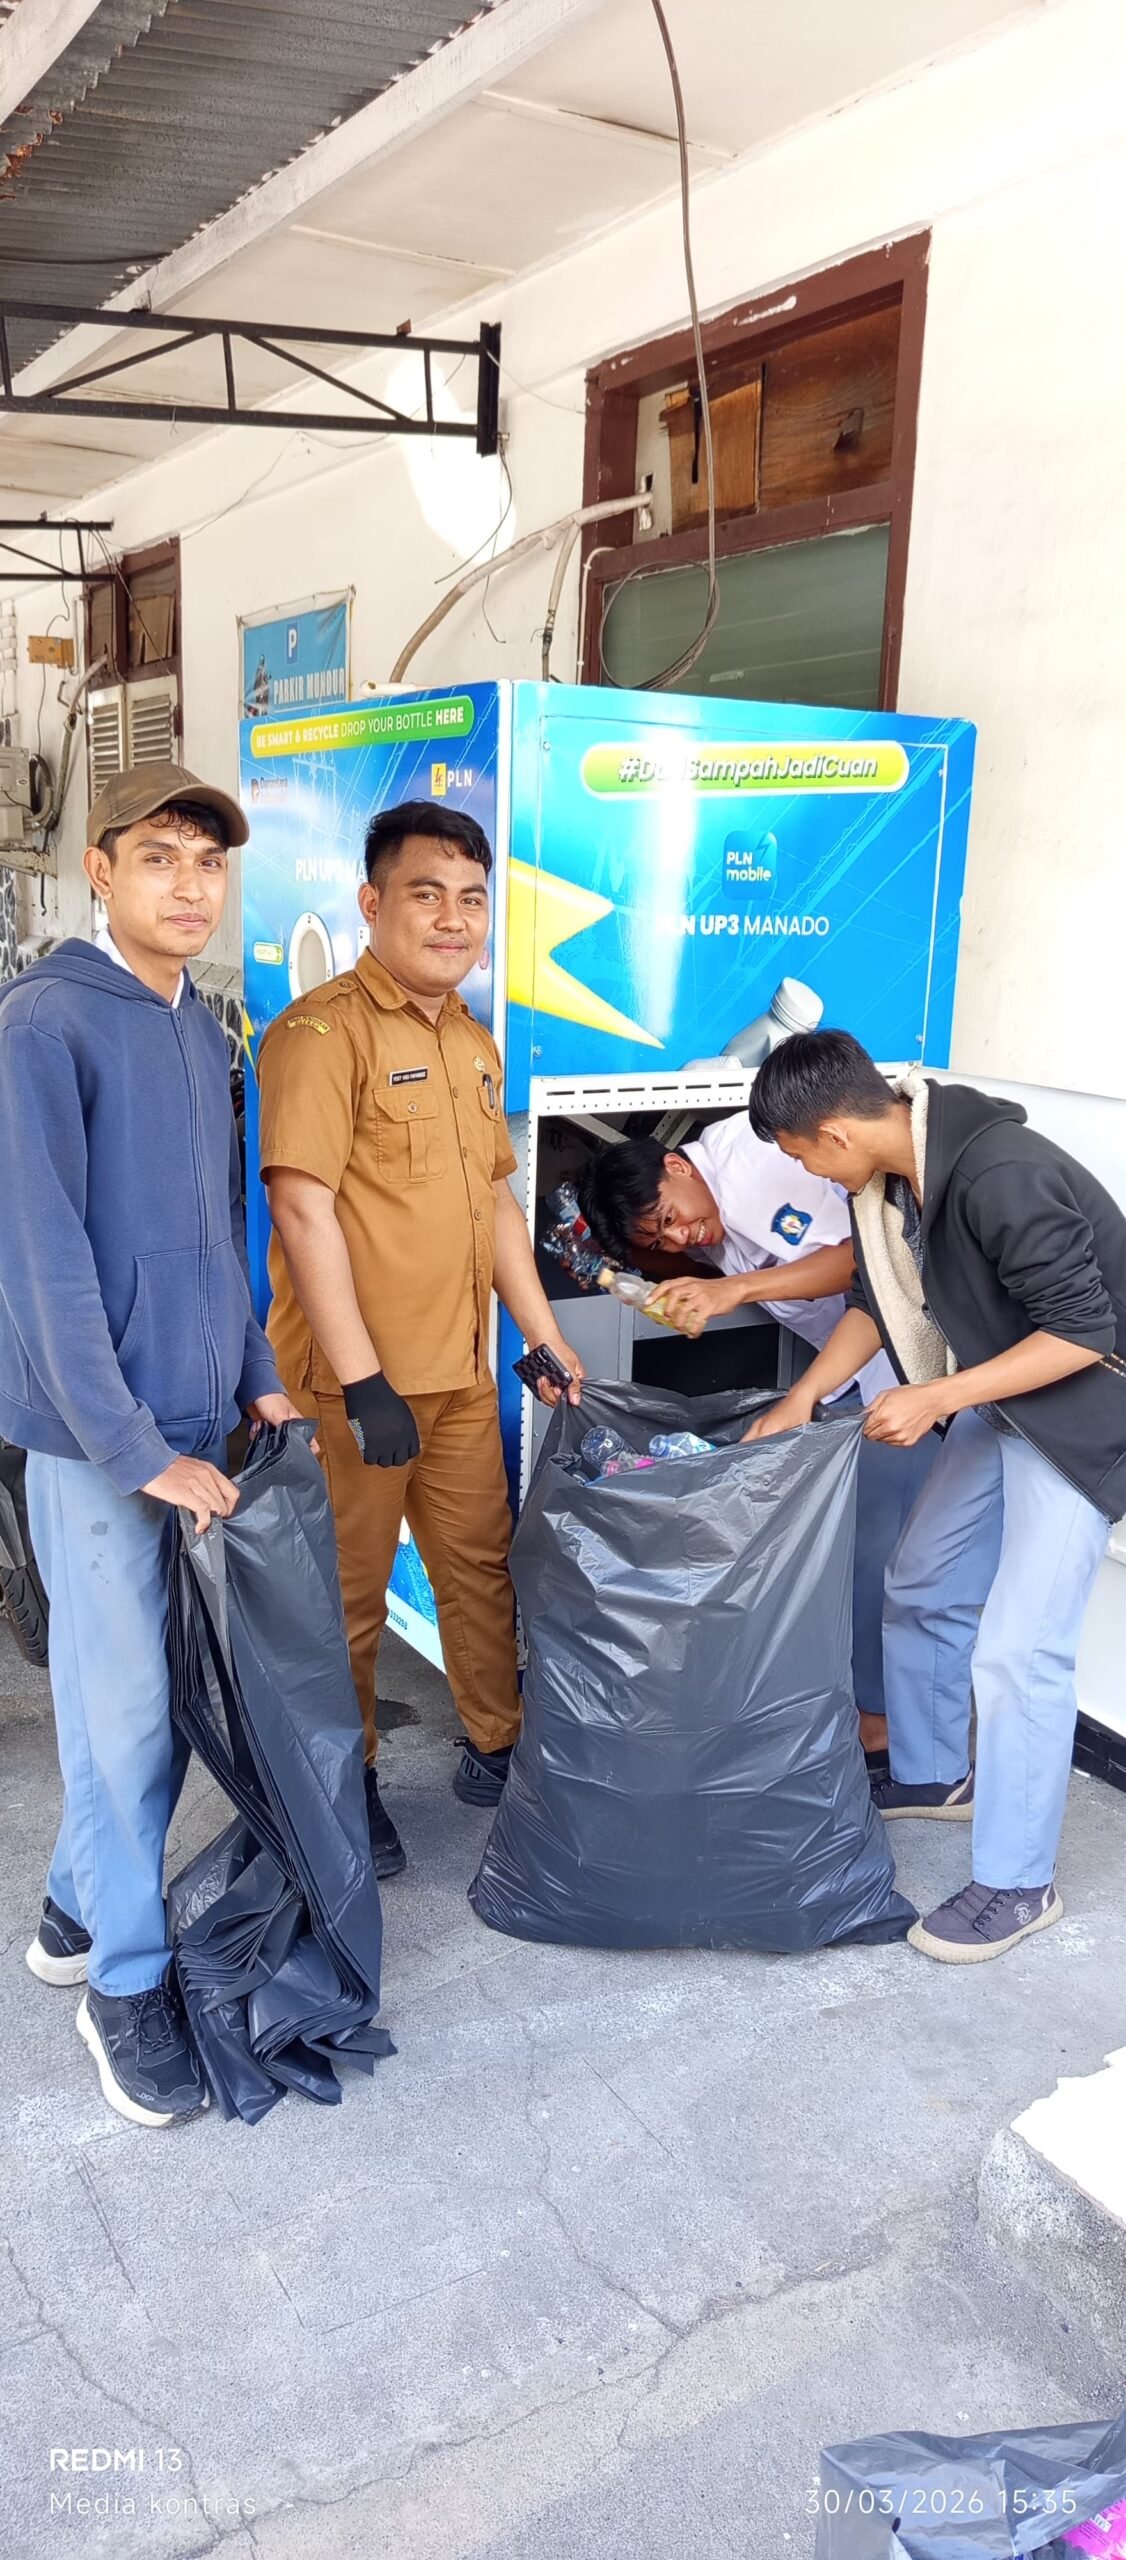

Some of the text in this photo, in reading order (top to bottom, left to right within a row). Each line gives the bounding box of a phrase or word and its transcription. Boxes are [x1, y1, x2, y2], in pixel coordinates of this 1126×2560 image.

[288, 629, 297, 658] P
[273, 674, 304, 705] PARKIR
[256, 735, 266, 748] BE
[267, 730, 293, 747] SMART
[303, 723, 339, 742] RECYCLE
[341, 719, 366, 737] DROP
[368, 716, 394, 734] YOUR
[396, 710, 433, 731] BOTTLE
[435, 706, 464, 726] HERE
[447, 769, 473, 788] PLN
[726, 851, 753, 865] PLN
[296, 858, 318, 881] PLN
[726, 865, 772, 882] mobile
[655, 914, 830, 936] LN UP3 MANADO
